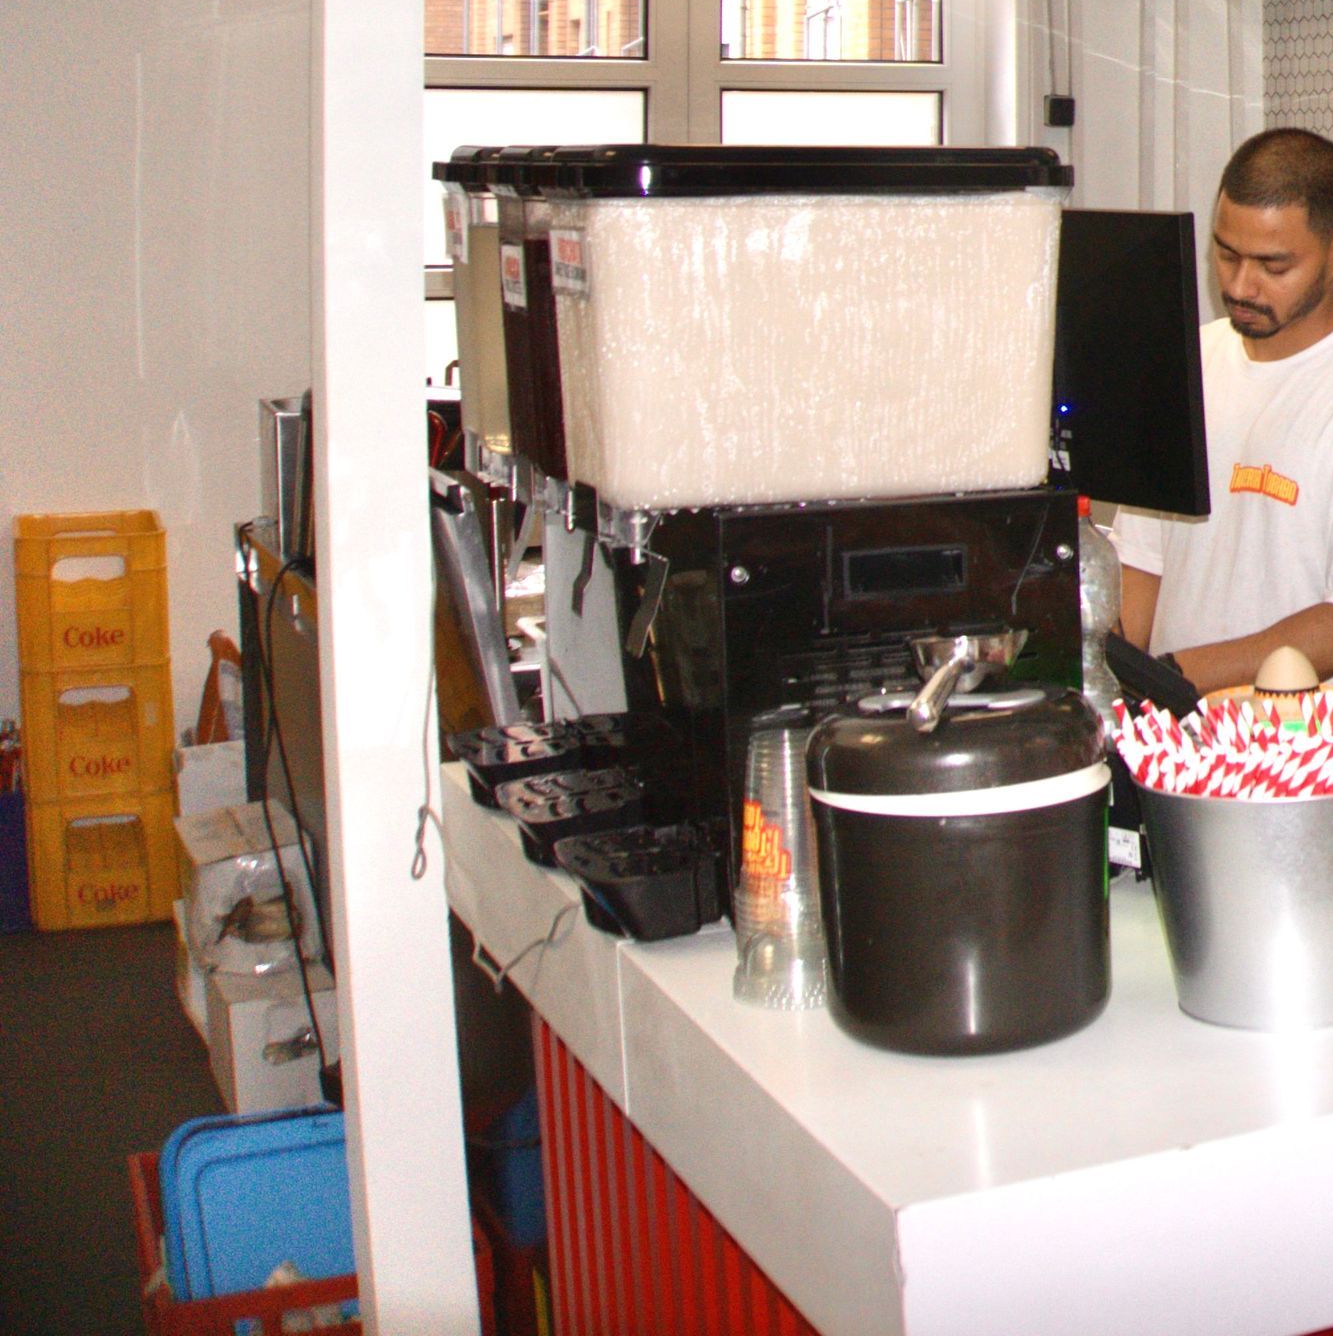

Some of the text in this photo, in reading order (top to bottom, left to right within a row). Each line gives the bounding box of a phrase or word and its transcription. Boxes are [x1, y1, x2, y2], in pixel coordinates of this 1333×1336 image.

[64, 626, 125, 649] Coke
[69, 754, 131, 777] Coke
[77, 882, 140, 905] Coke
